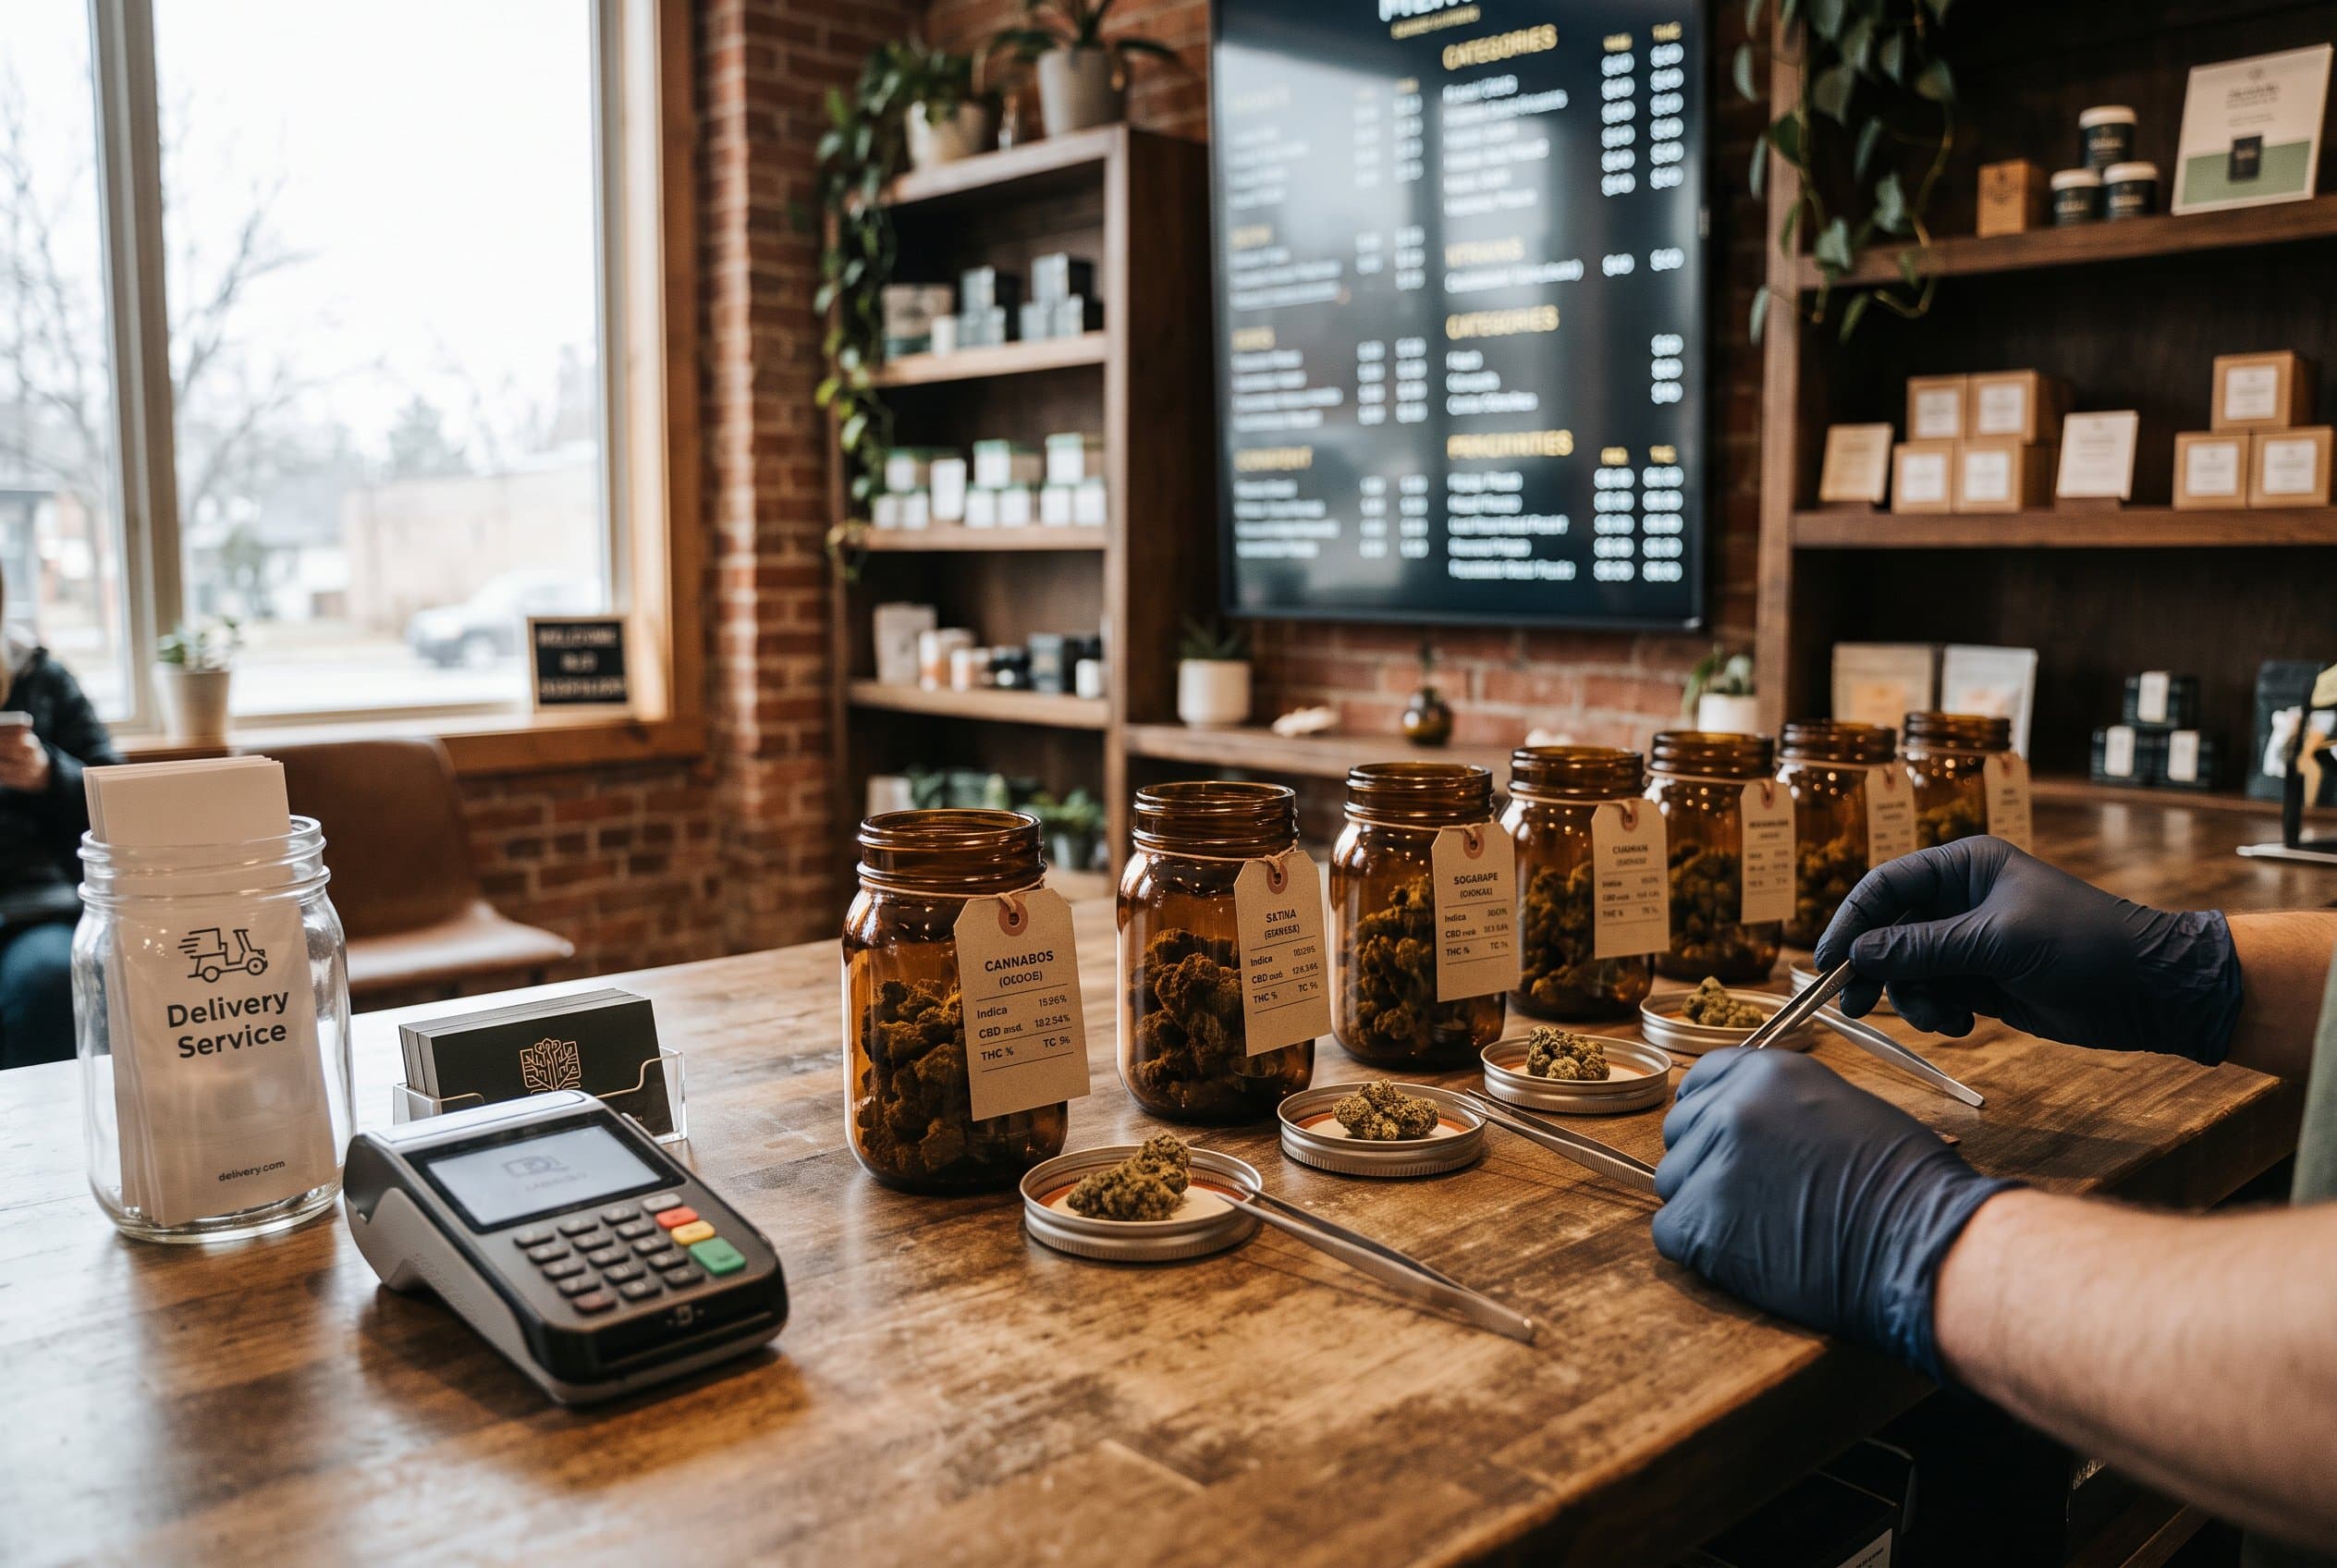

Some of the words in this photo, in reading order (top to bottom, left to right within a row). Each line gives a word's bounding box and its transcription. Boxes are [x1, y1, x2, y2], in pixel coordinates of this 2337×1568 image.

[1444, 913, 1466, 923] Indica
[985, 950, 1054, 972] CANNABOS
[1251, 956, 1272, 966] Indica
[1252, 974, 1267, 985] CBD
[1254, 994, 1269, 1004] THC
[167, 991, 289, 1028] Delivery
[977, 1006, 1008, 1019] Indica
[979, 1026, 1001, 1039] CBD
[177, 1023, 288, 1059] Service
[981, 1048, 1003, 1061] THC
[1043, 1037, 1057, 1048] TC
[218, 1160, 286, 1182] delivery.com
